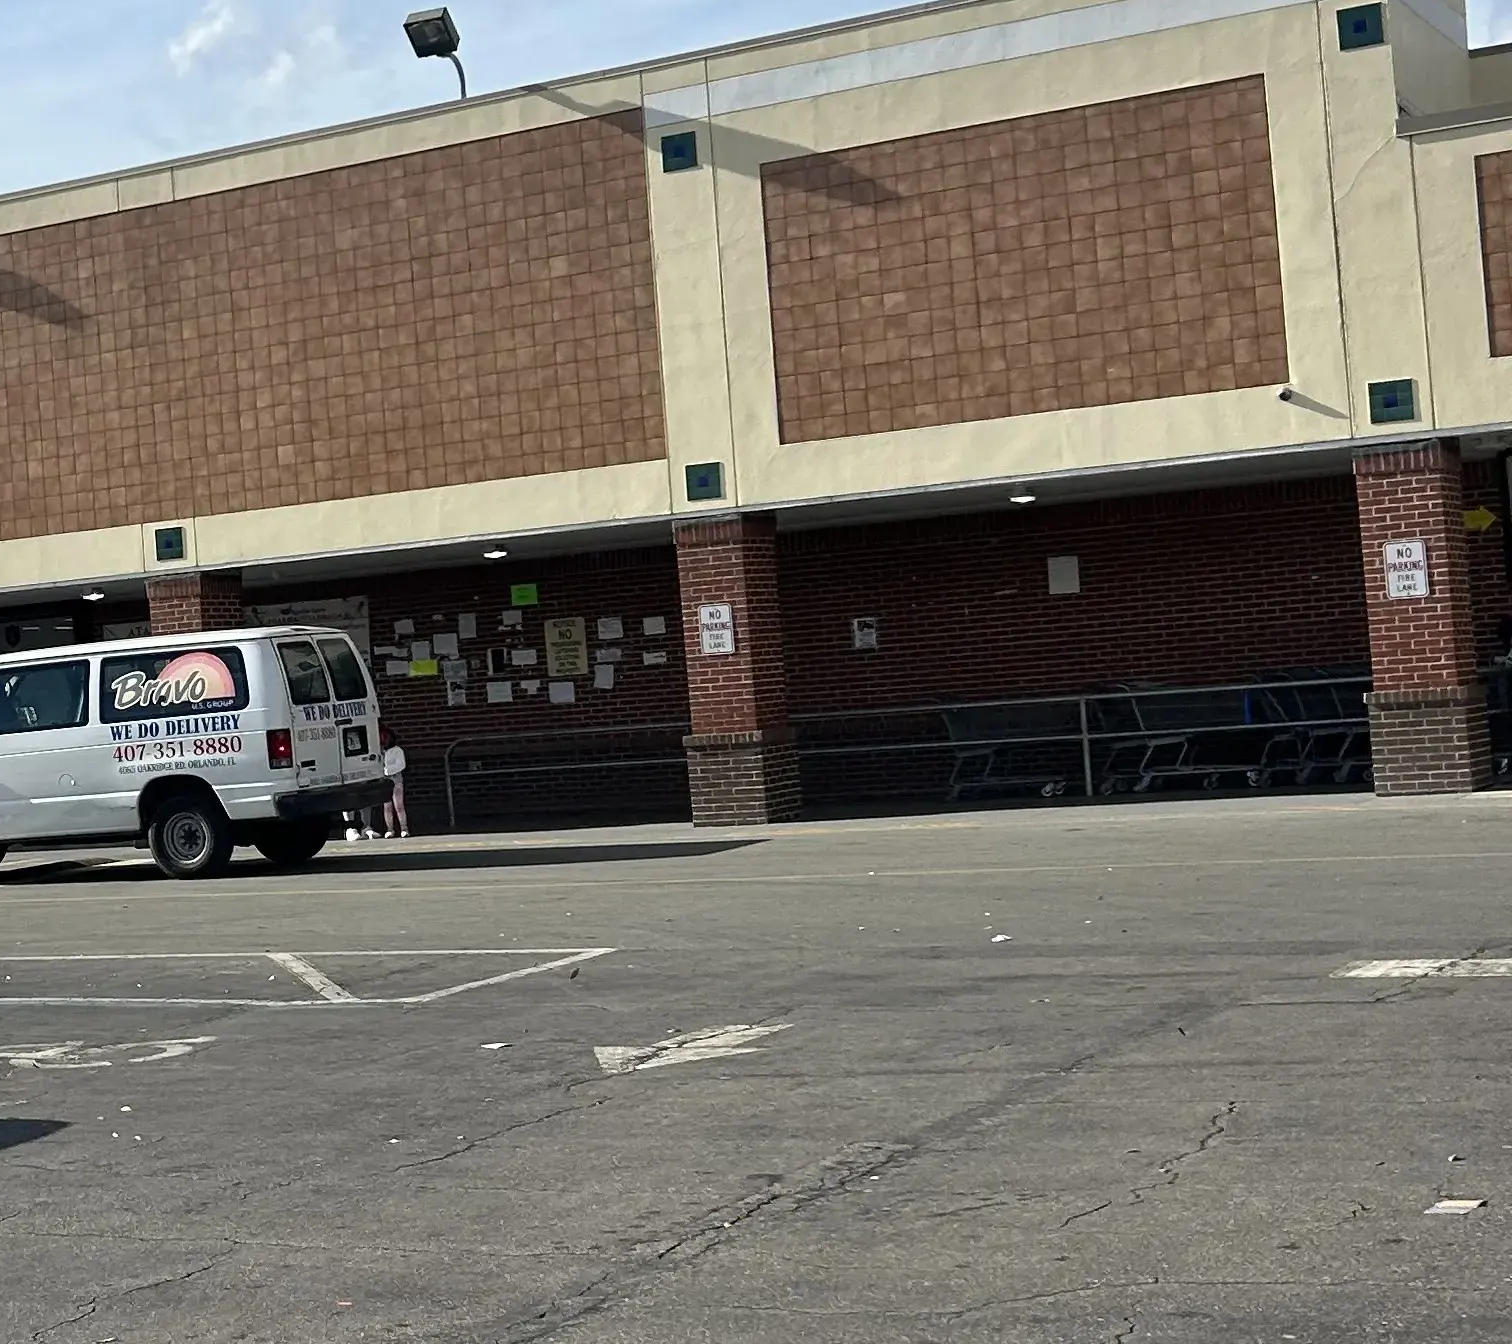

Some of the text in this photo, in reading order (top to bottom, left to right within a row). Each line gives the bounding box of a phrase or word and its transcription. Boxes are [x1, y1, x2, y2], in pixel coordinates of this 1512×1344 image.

[1397, 548, 1412, 559] NO
[1388, 560, 1424, 572] PARKING
[709, 609, 722, 620] NO
[701, 621, 731, 632] PARKING
[558, 628, 572, 640] NO
[111, 670, 208, 709] Bravo
[207, 699, 234, 709] GROUP
[303, 701, 366, 721] WE DO DELIVERY
[110, 714, 241, 741] WE DO DELIVERY
[113, 735, 243, 763] 407-351-8880
[226, 757, 236, 766] FL
